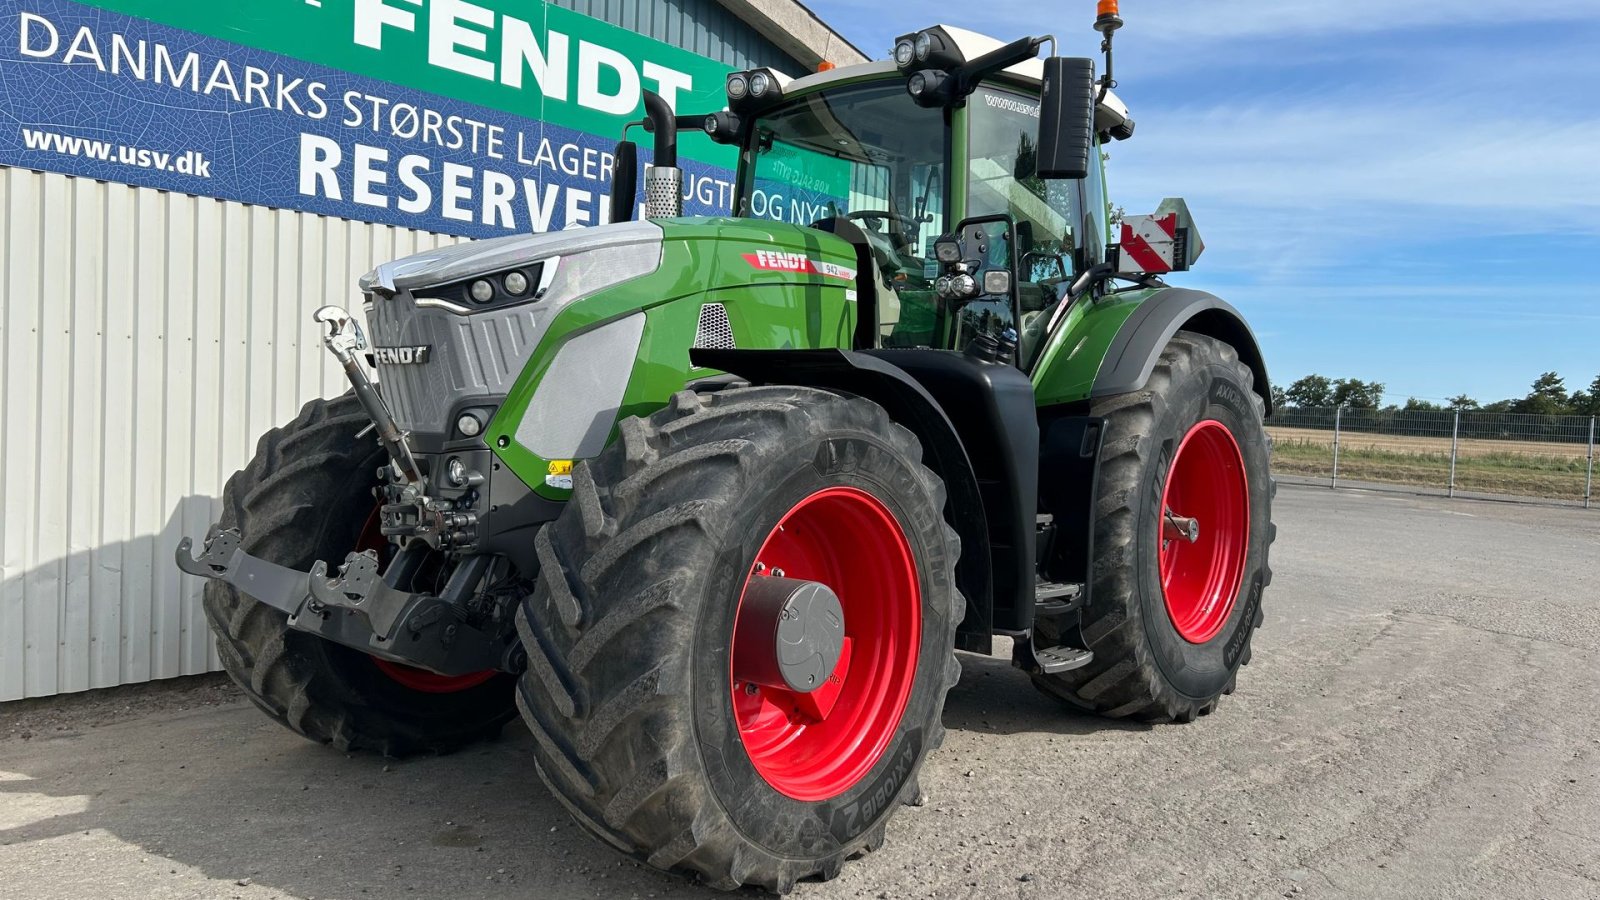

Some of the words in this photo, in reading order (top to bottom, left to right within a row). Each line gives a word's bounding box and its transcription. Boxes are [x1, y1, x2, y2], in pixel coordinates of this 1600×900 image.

[354, 0, 692, 115] FENDT
[20, 11, 327, 119] DANMARKS
[344, 91, 504, 159] STØRSTE
[517, 131, 615, 182] LAGER
[750, 189, 783, 221] OG
[22, 128, 211, 179] www.usv.dk
[299, 131, 610, 234] RESERVE
[755, 250, 808, 270] FENDT
[825, 264, 839, 275] 942
[373, 345, 427, 364] FENDT
[861, 741, 913, 822] AXIOBIB
[843, 801, 861, 837] 2
